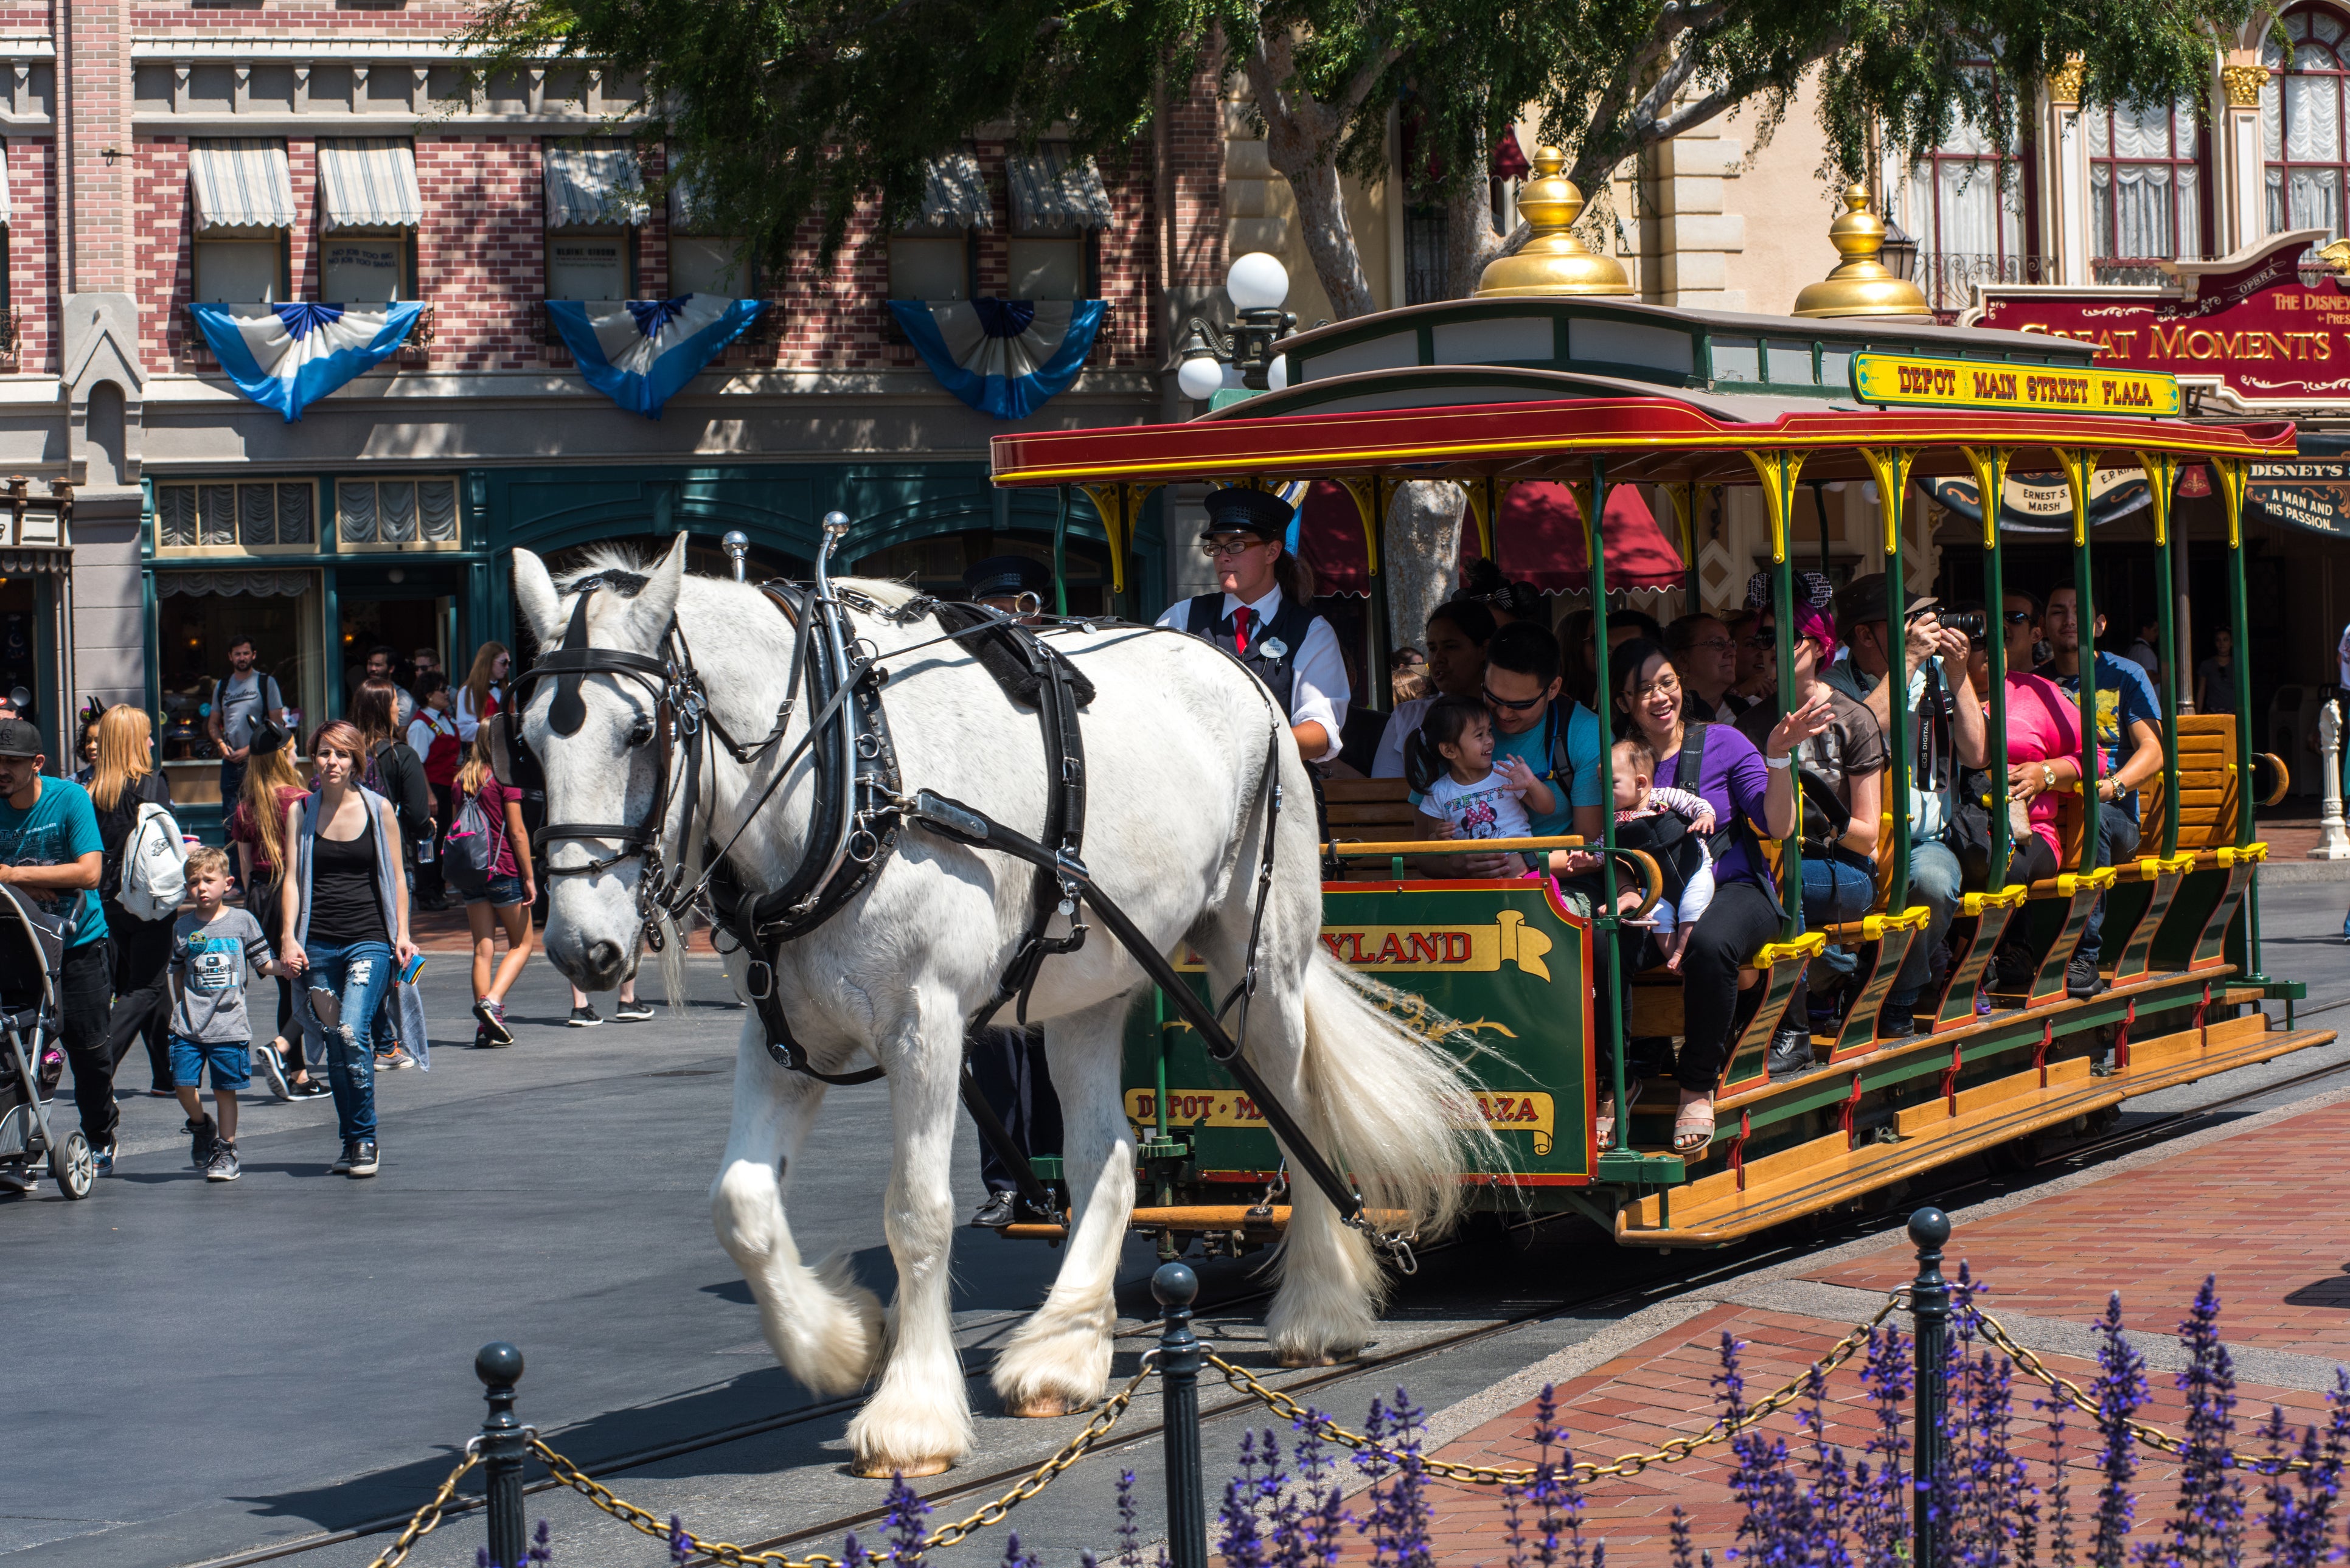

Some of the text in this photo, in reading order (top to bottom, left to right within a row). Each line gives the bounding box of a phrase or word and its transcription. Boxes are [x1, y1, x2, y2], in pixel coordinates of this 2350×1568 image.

[2239, 268, 2278, 293] OPERA
[2272, 293, 2300, 310] THE
[2149, 325, 2331, 361] MOMENTS
[1898, 366, 2153, 405] DEPOT MAIN STREET PLAZA
[2101, 470, 2115, 484] E.P.
[2250, 465, 2343, 476] DISNEY'S
[2023, 489, 2068, 500] ERNEST S.
[2029, 501, 2060, 512] MARSH
[2272, 489, 2333, 516] A MAN AND
[2265, 503, 2340, 532] HIS PASSION...
[1444, 786, 1504, 814] PRETTY
